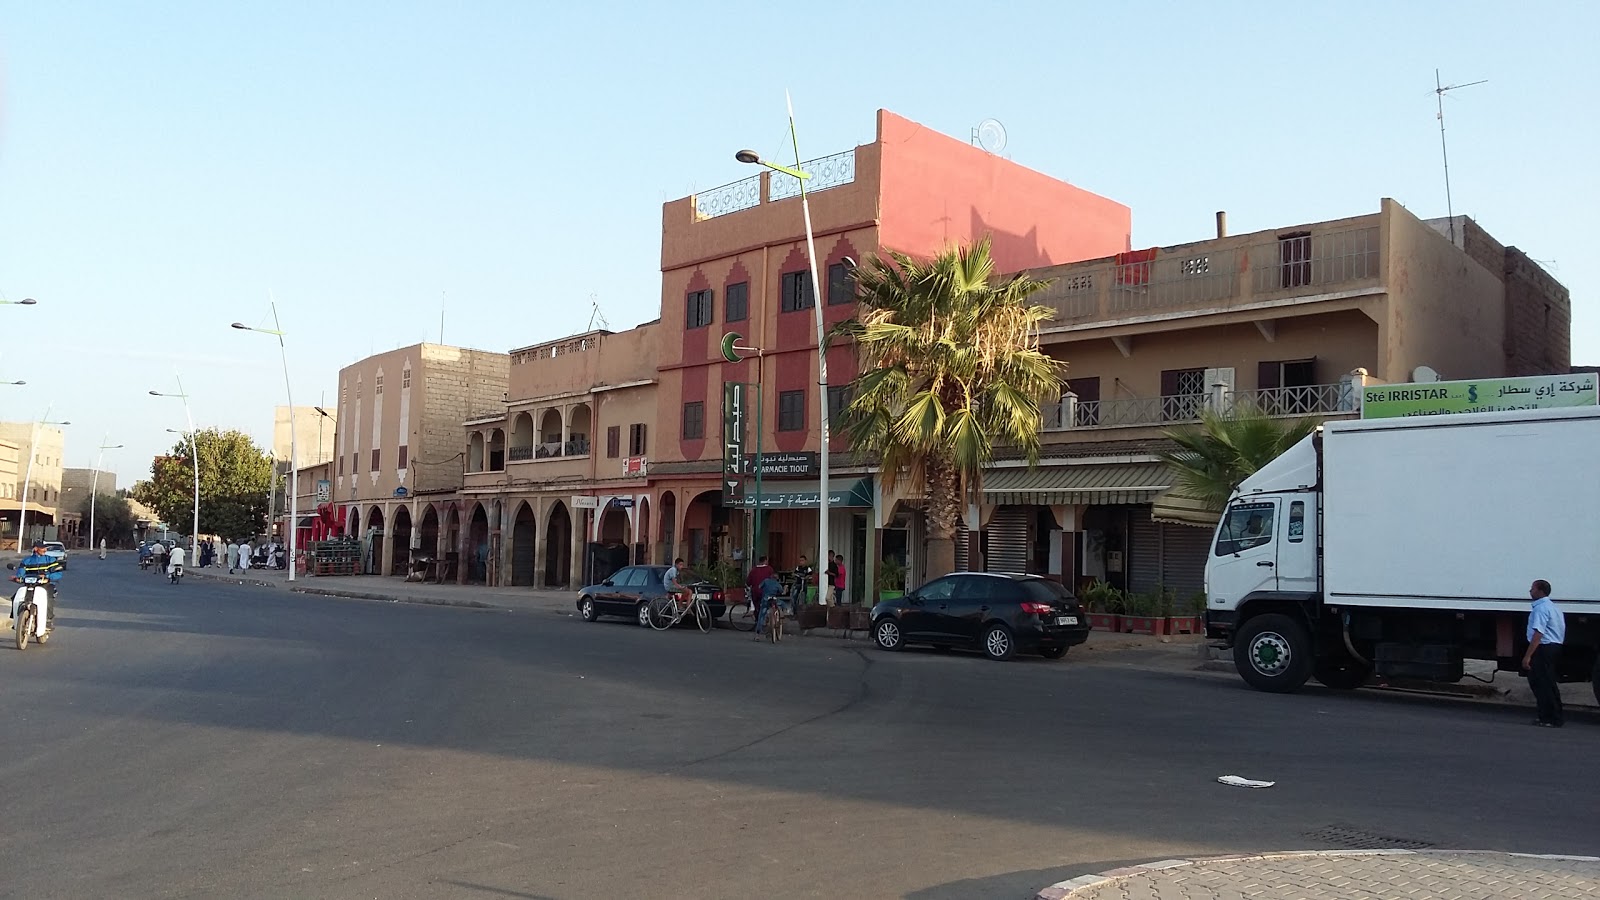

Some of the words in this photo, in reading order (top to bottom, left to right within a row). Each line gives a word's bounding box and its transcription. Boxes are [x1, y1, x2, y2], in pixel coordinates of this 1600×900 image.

[1498, 385, 1531, 398] سطار
[1535, 383, 1555, 400] إري
[1559, 379, 1593, 394] شركة
[1366, 390, 1385, 403] Sté
[1388, 388, 1448, 401] IRRISTAR
[727, 385, 742, 473] صيدلية
[753, 465, 788, 474] PARMACIE
[790, 464, 808, 473] TIOUT
